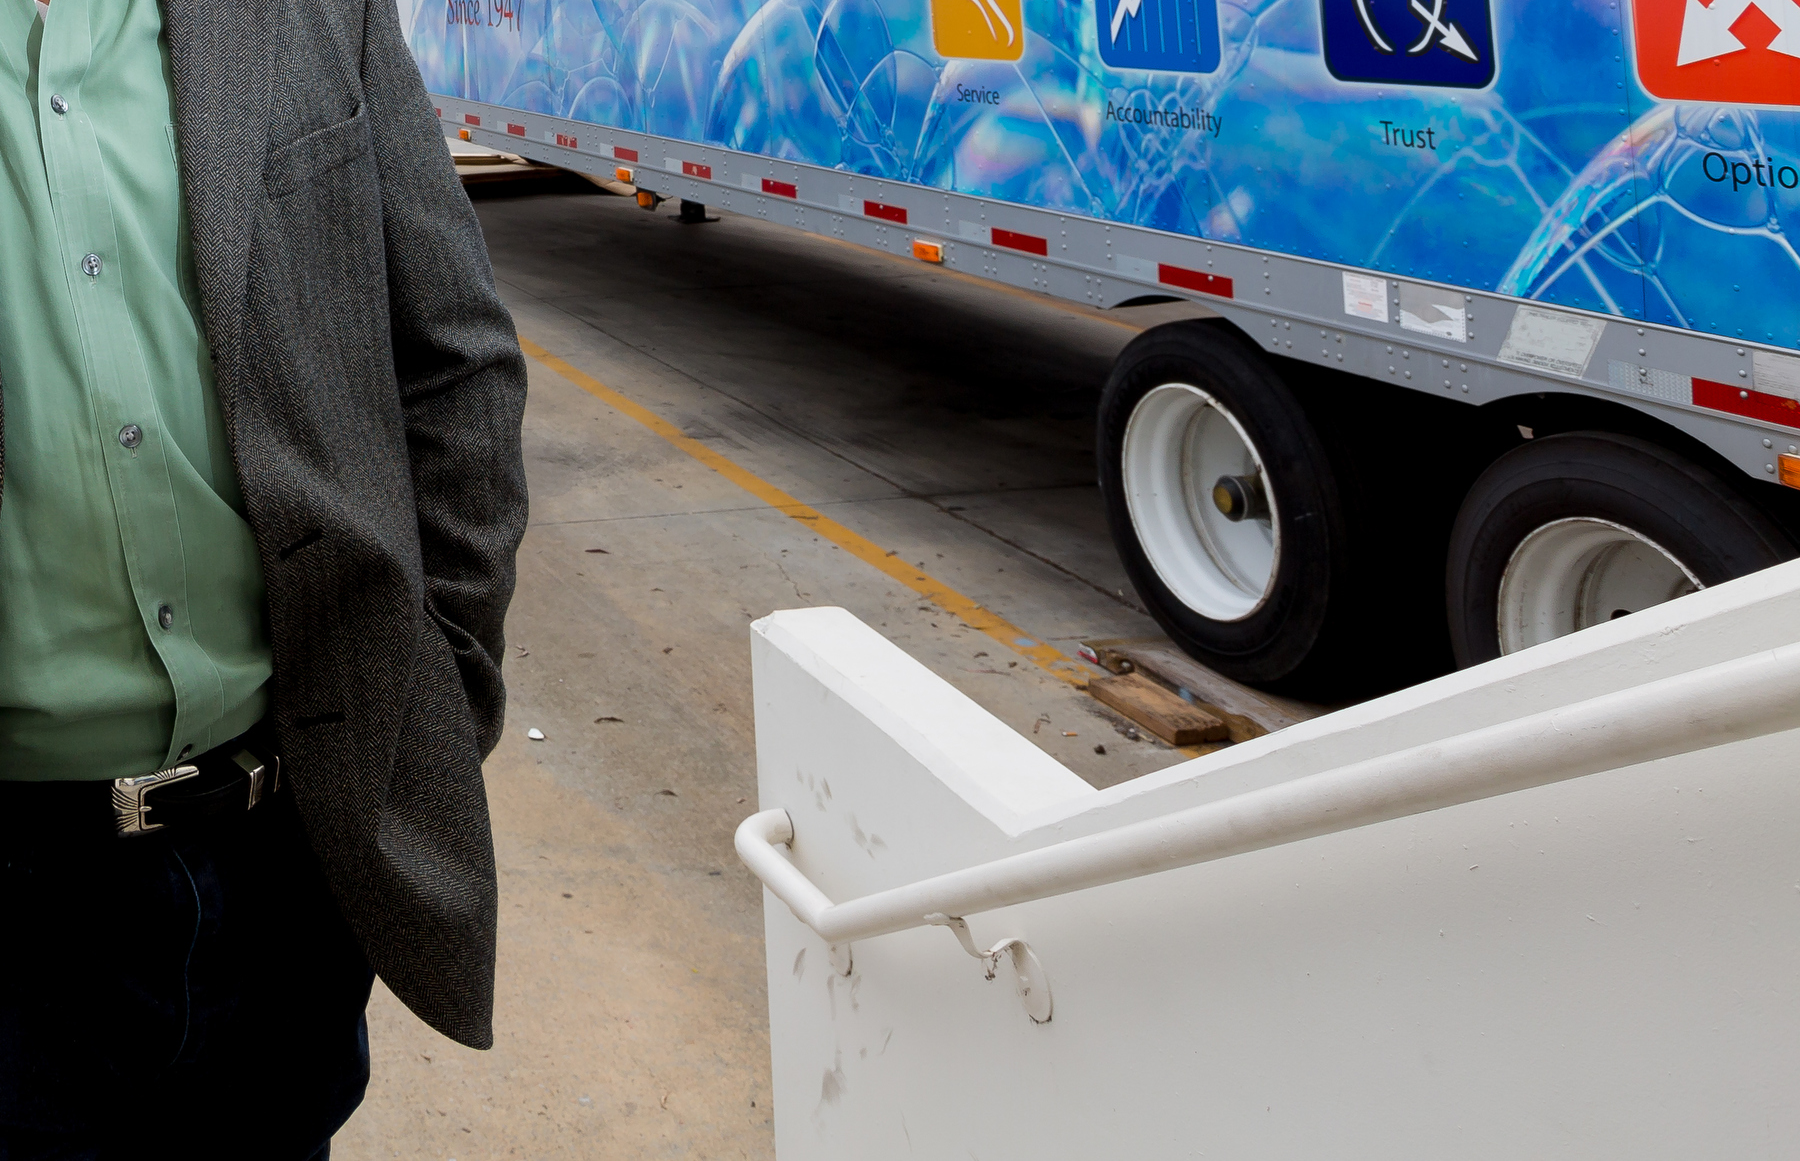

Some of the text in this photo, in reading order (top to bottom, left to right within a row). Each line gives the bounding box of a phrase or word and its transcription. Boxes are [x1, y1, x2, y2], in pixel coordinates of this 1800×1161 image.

[956, 83, 1000, 106] Service
[1106, 100, 1222, 138] Accountability
[1379, 120, 1436, 150] Trust
[1702, 151, 1799, 192] Optio
